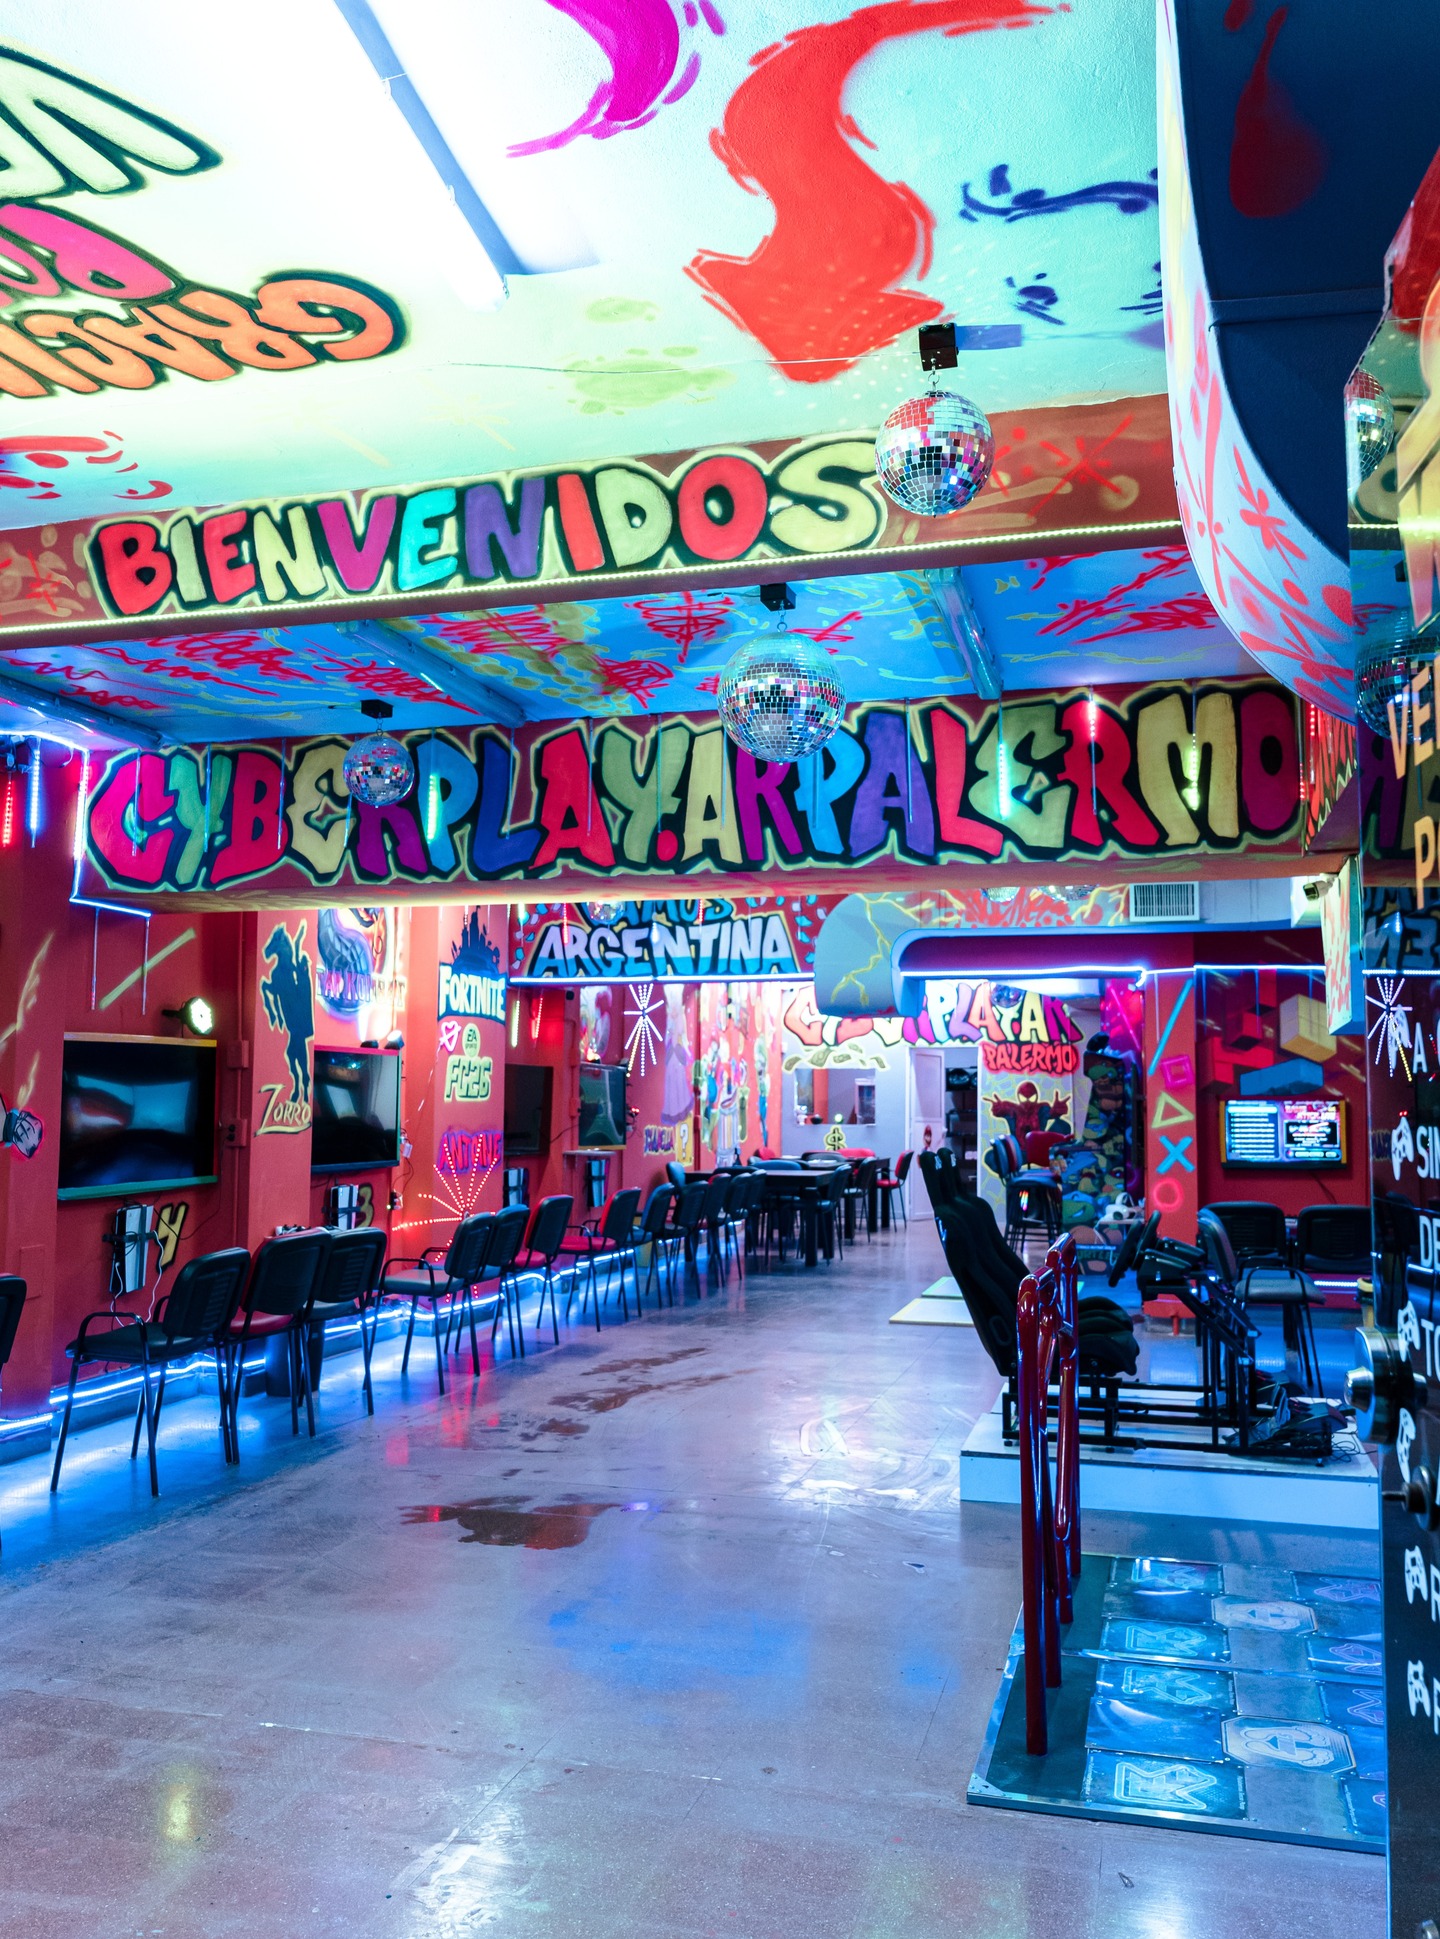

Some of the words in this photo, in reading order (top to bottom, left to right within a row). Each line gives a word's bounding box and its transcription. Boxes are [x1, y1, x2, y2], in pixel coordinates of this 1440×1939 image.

[97, 440, 880, 614] BIENVENIDOS
[532, 914, 802, 977] ARGENTINA
[438, 965, 506, 1021] FORTNITE
[466, 1028, 477, 1042] EA
[984, 1042, 1077, 1074] PALERMO
